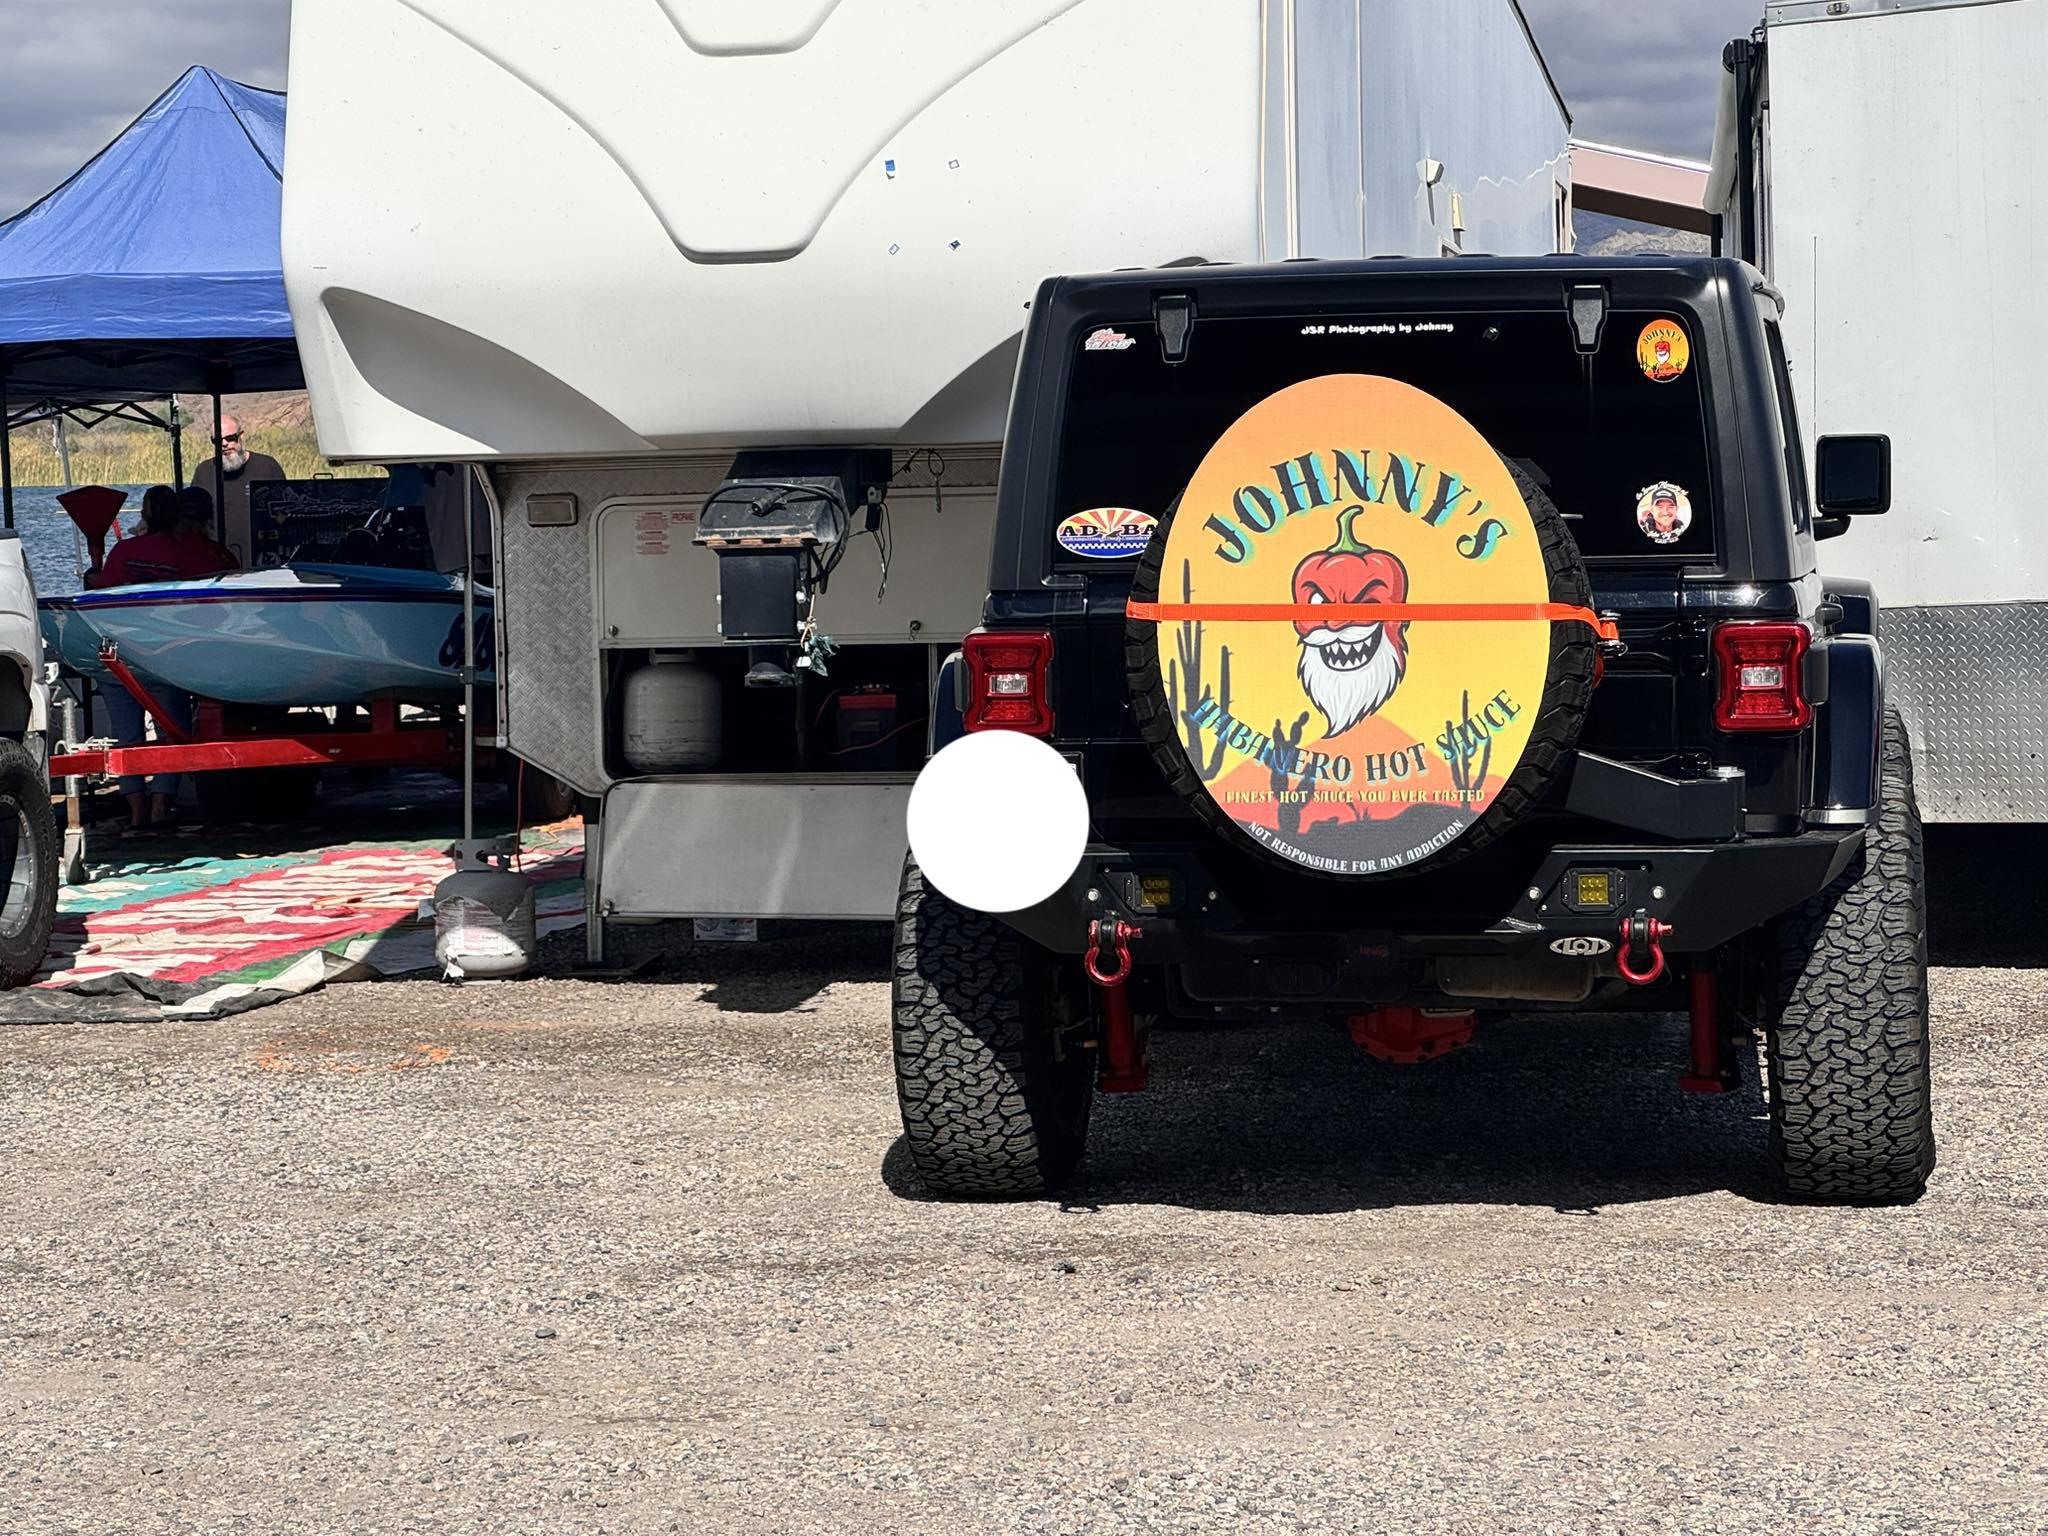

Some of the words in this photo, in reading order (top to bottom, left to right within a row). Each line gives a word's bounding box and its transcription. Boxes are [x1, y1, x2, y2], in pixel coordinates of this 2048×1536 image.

[1301, 325, 1325, 335] JSR
[1329, 323, 1396, 335] Photography
[1399, 323, 1412, 334] by
[1415, 321, 1454, 334] Johnny
[1202, 448, 1511, 564] JOHNNY'S
[1192, 698, 1351, 783] HABANERO
[1366, 743, 1426, 783] HOT
[1435, 689, 1521, 761] SAUCE
[1225, 790, 1274, 804] FINEST
[1280, 790, 1308, 804] HOT
[1313, 790, 1353, 803] SAUCE
[1359, 790, 1386, 803] YOU
[1391, 789, 1428, 803] EVER
[1433, 788, 1485, 802] TASTED
[1248, 820, 1270, 843] NOT
[1271, 837, 1347, 872] RESPONSIBLE
[1352, 859, 1376, 872] FOR
[1380, 855, 1403, 870] ANY
[1406, 819, 1464, 862] ADDICTION
